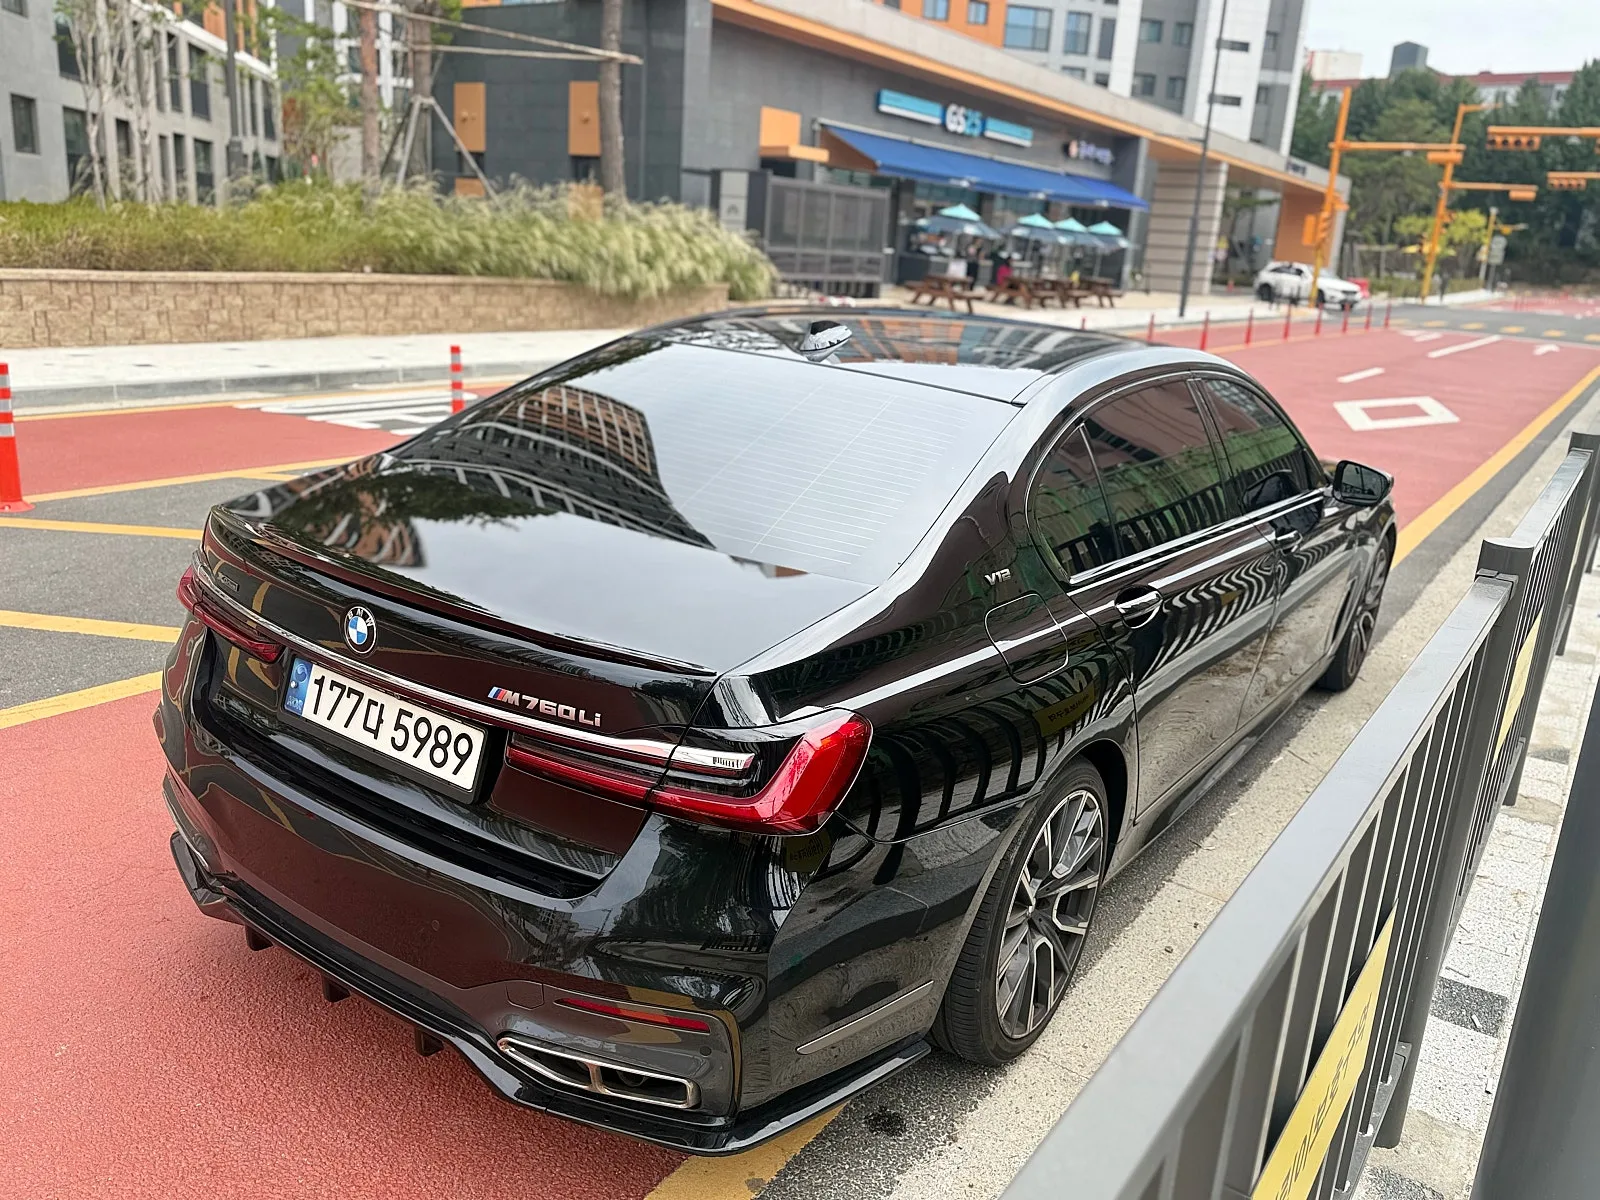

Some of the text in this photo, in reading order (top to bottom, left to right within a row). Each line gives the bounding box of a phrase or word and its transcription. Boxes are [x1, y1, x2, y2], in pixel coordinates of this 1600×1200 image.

[984, 568, 1011, 586] V12
[347, 608, 374, 627] BMW
[501, 690, 602, 727] M760Li
[313, 675, 474, 776] 177다 5989
